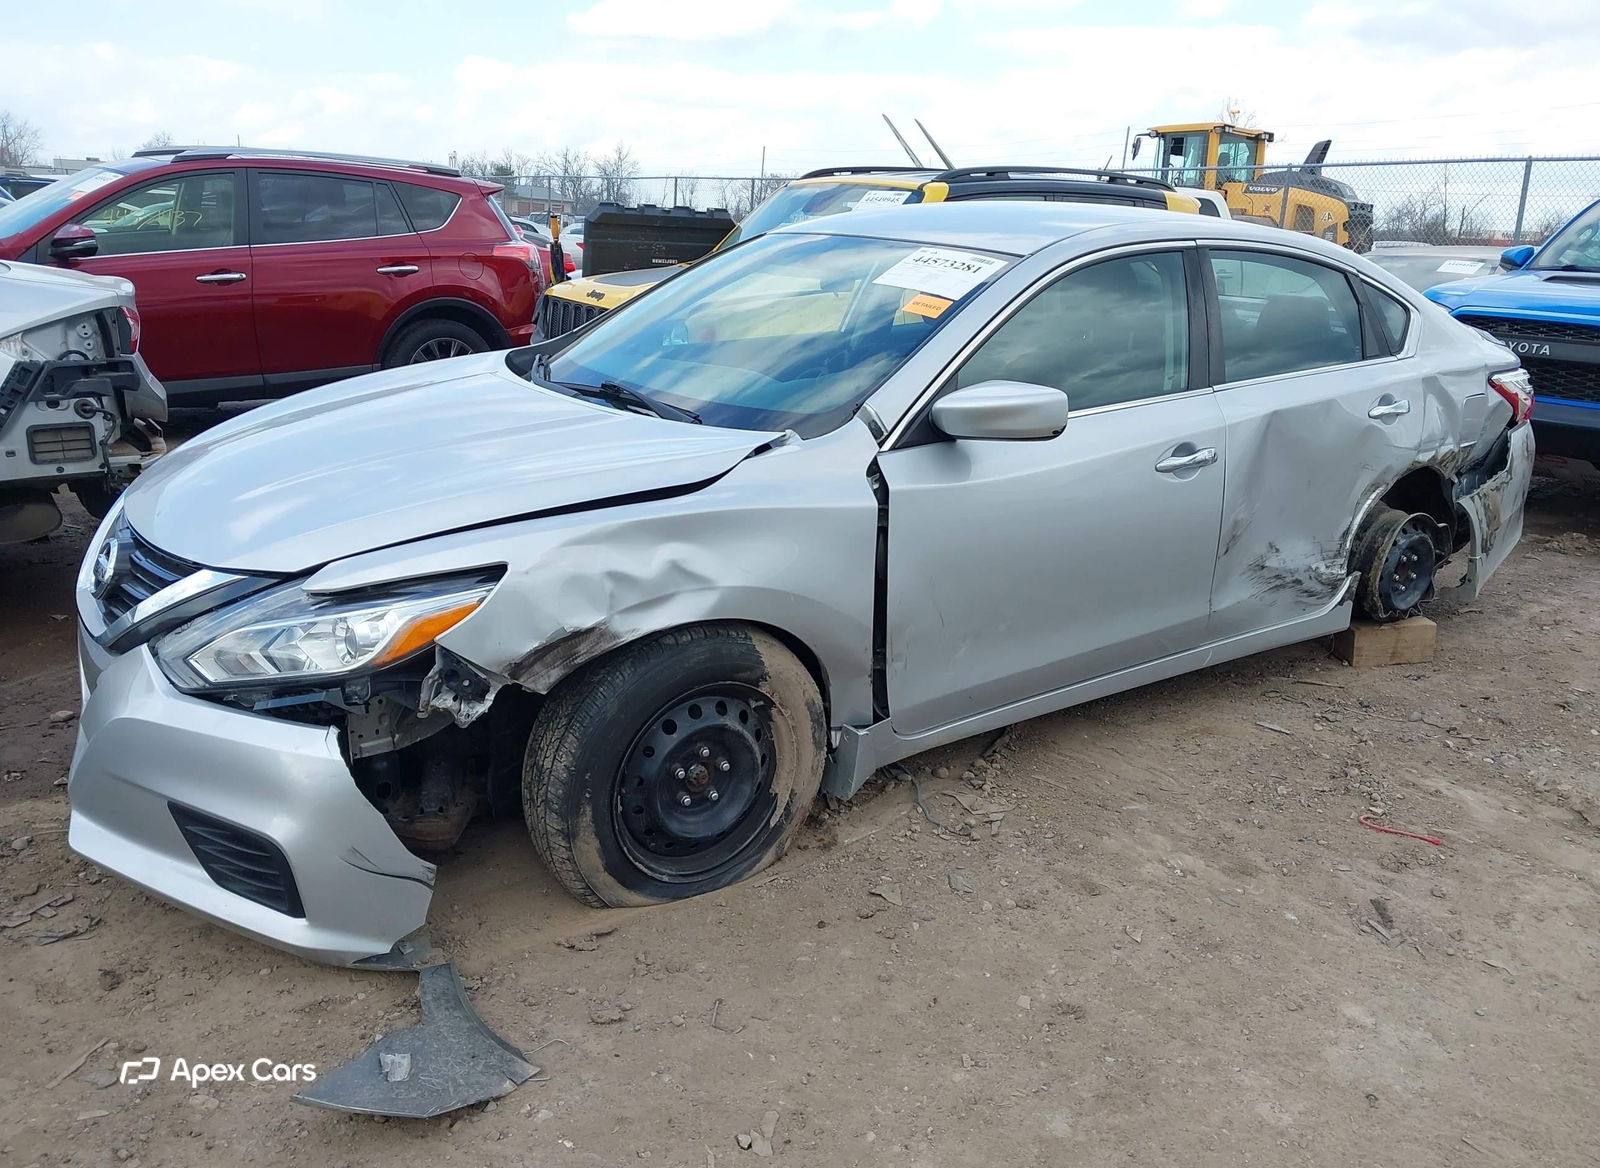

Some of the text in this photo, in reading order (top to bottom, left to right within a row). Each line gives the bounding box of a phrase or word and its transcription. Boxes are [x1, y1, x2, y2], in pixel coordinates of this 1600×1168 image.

[913, 256, 983, 274] 44573281
[586, 289, 606, 301] Jeep
[912, 301, 942, 311] DETAILED
[1508, 341, 1550, 356] YOTA
